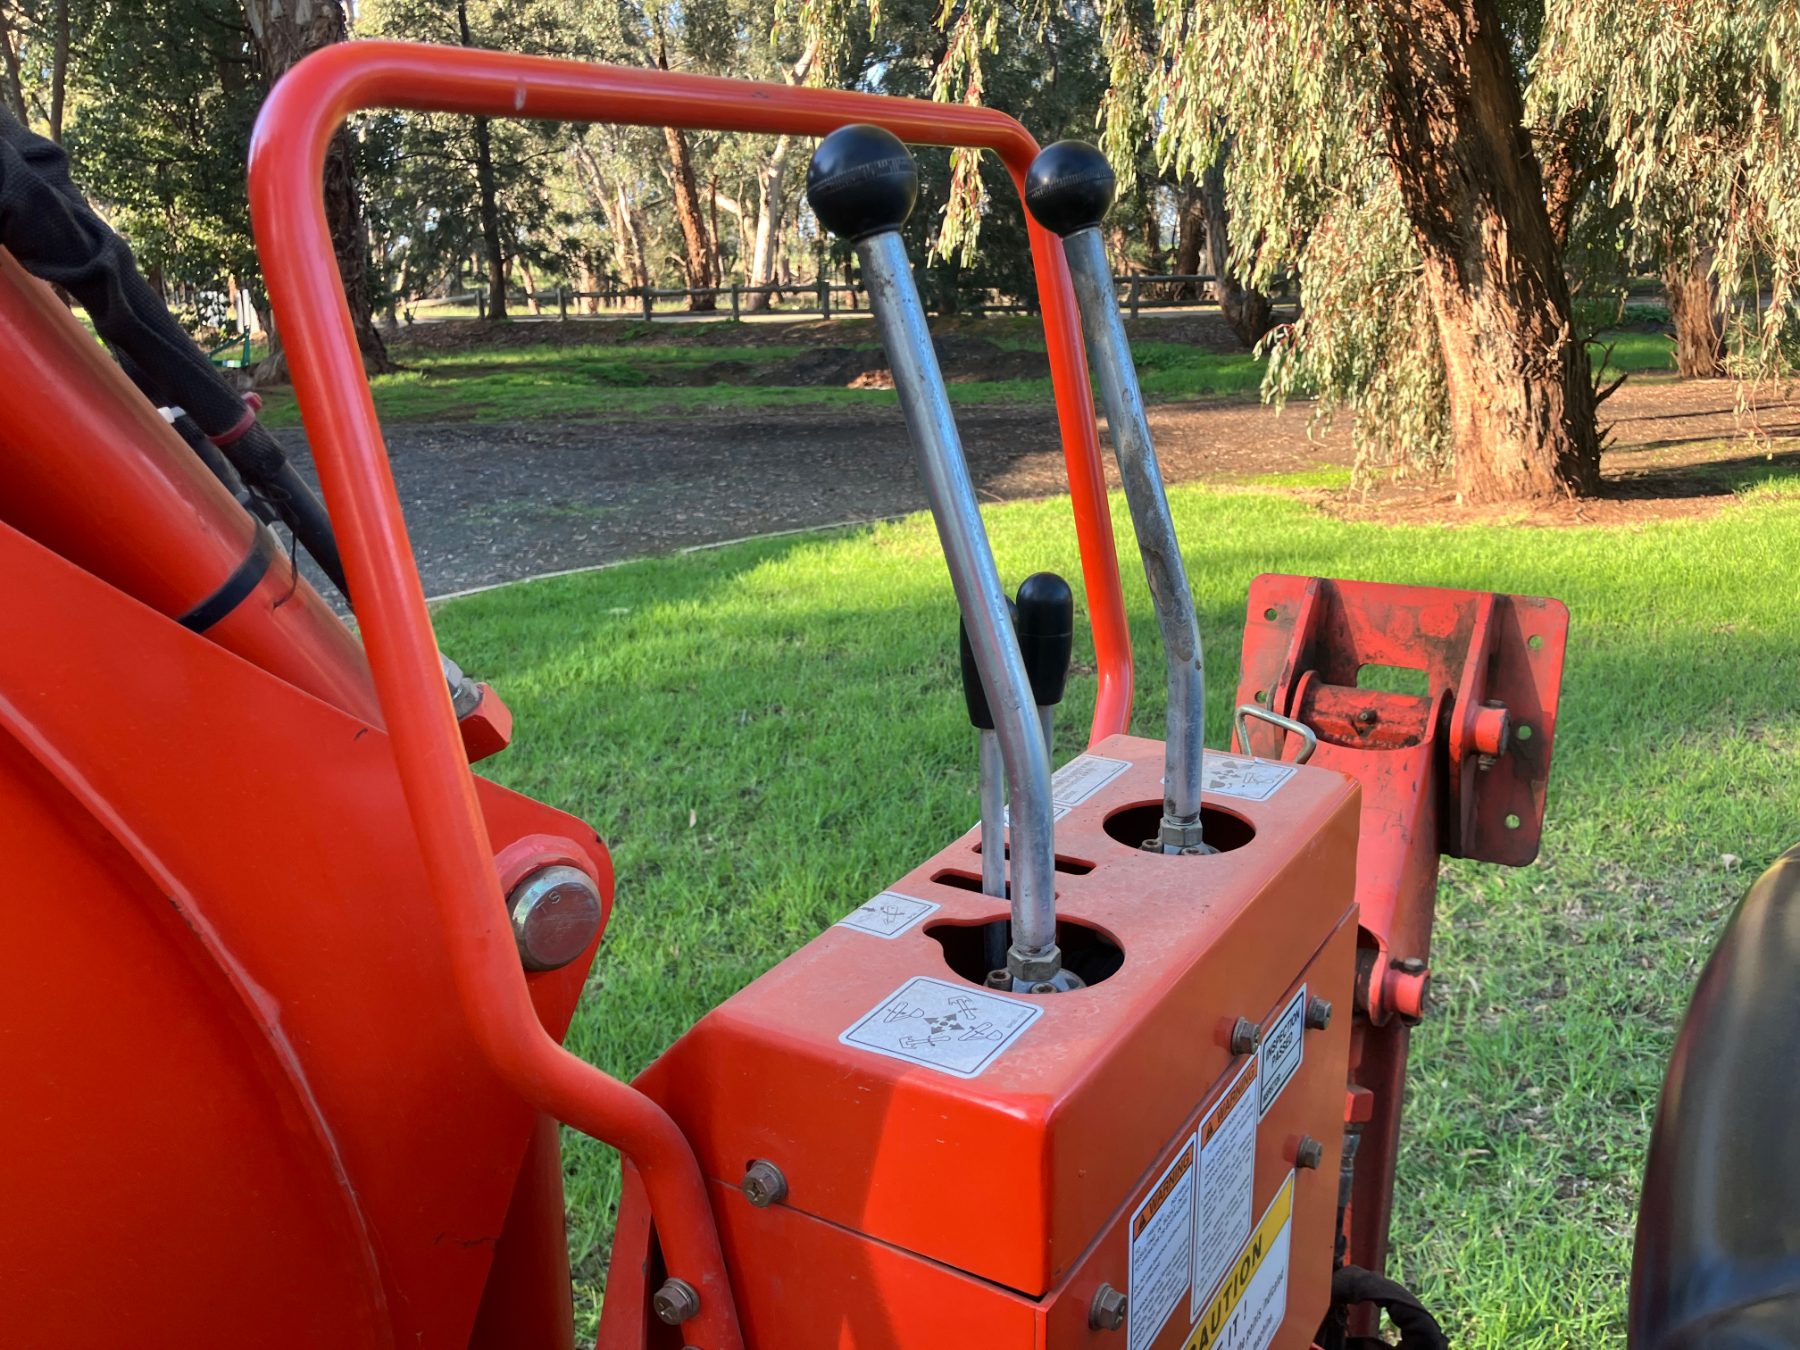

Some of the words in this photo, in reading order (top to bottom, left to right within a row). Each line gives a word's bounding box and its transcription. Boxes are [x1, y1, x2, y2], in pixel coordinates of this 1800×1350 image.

[1266, 1007, 1301, 1062] INSPECTION
[1271, 1031, 1293, 1069] PASSED
[1217, 1064, 1256, 1123] WARNING
[1149, 1152, 1190, 1215] WARNING
[1189, 1233, 1263, 1350] AUTION
